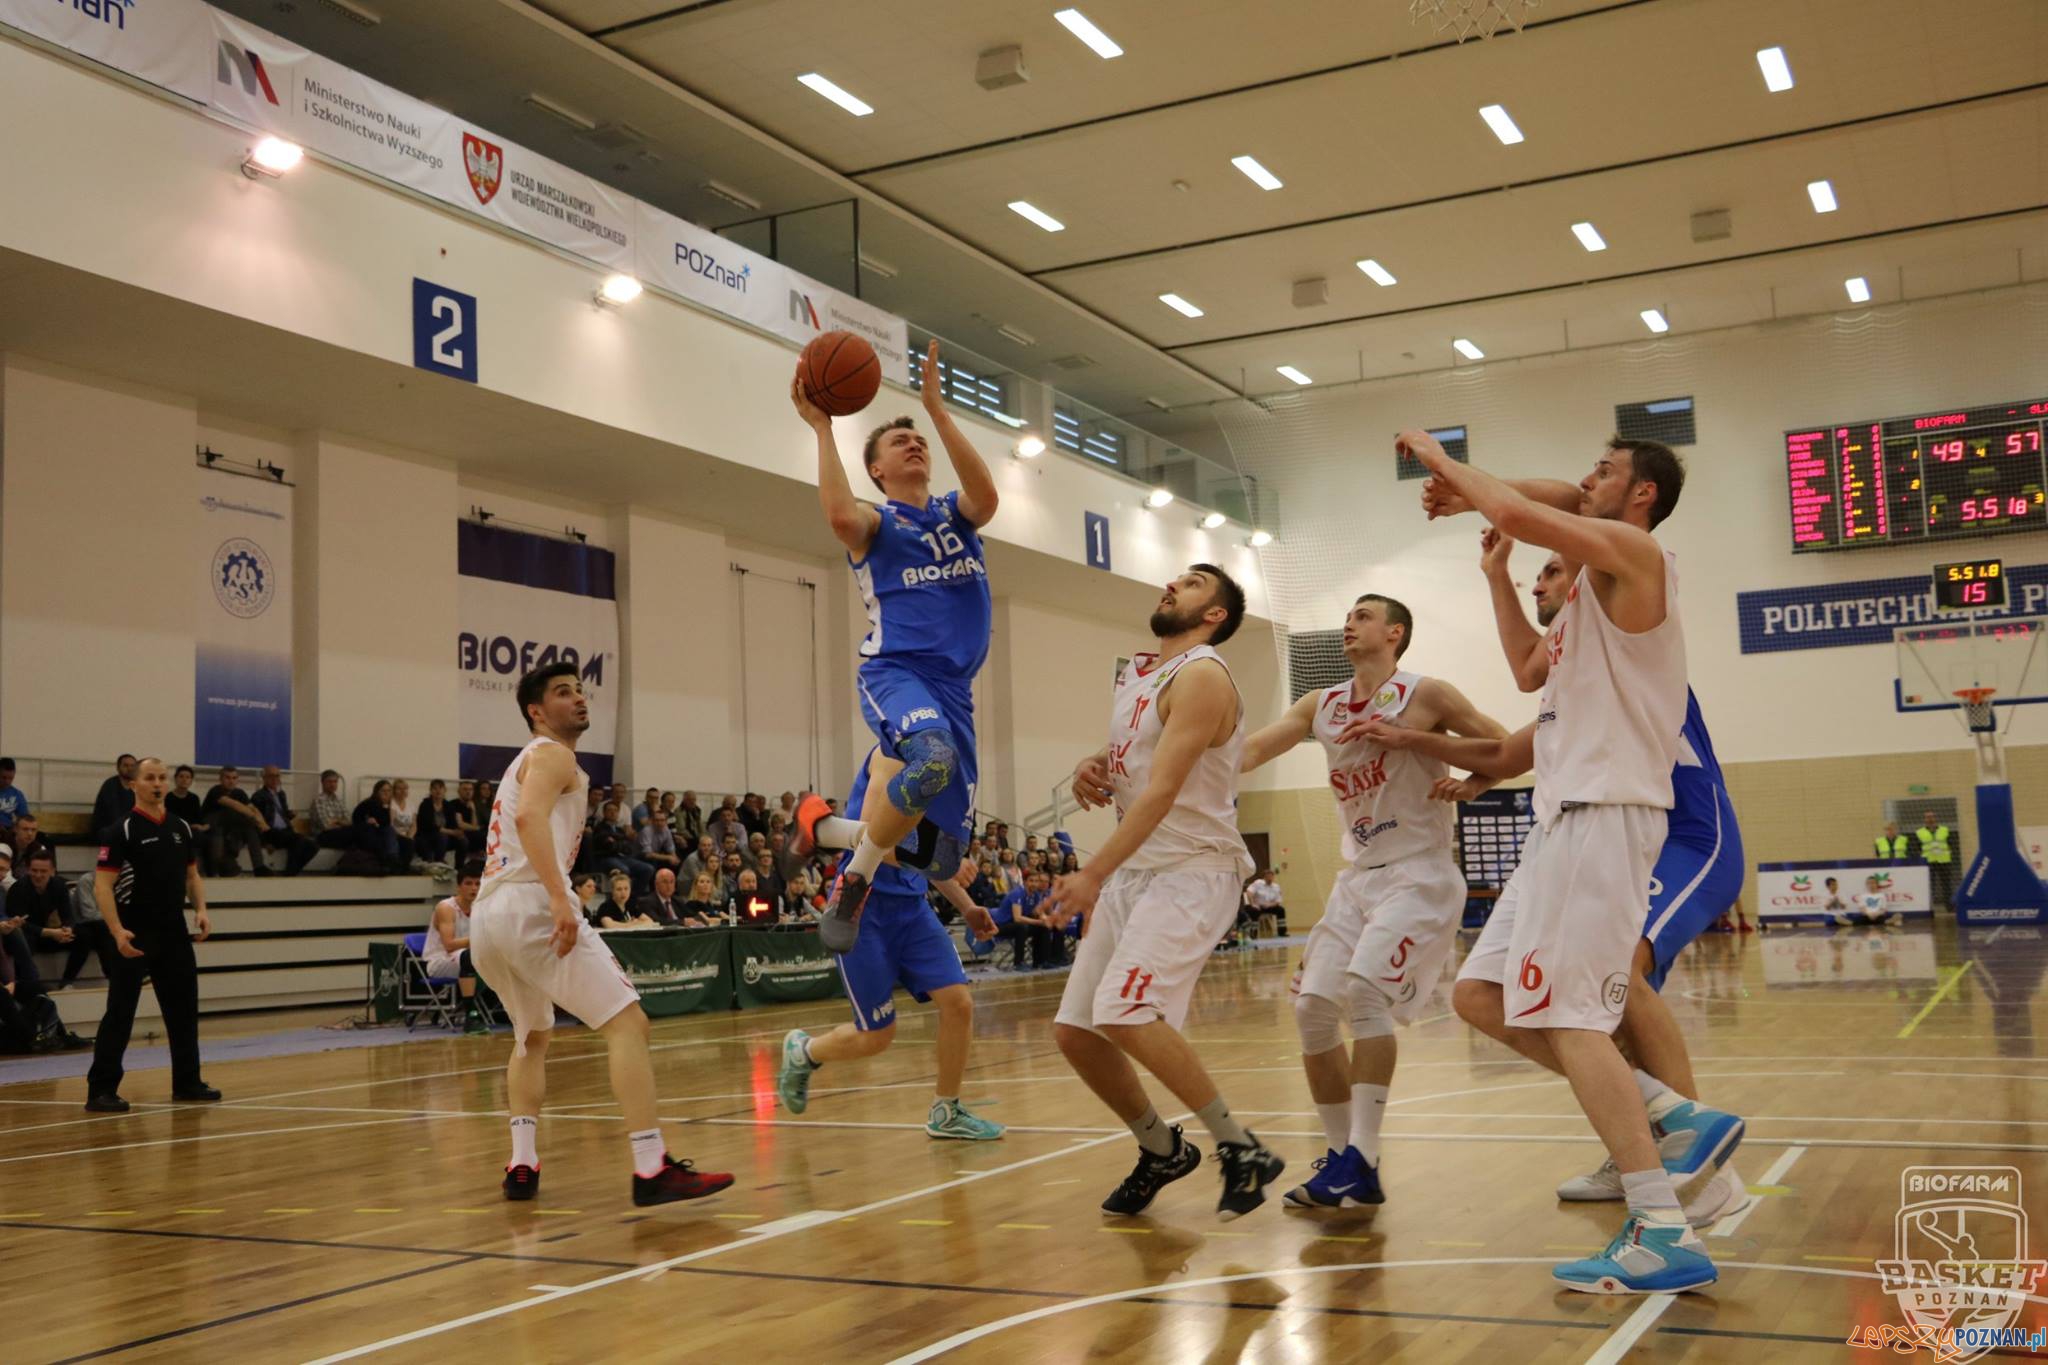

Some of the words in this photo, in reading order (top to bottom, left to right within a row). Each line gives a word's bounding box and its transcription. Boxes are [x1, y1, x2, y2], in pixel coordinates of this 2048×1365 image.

[304, 77, 385, 124] Ministerstwo
[387, 113, 422, 140] Nauki
[311, 102, 384, 144] Szkolnictwa
[431, 295, 463, 369] 2
[1914, 413, 1967, 429] BIOFARM
[1932, 440, 1964, 462] 49
[2005, 431, 2040, 455] 57
[919, 522, 965, 561] 16
[1094, 520, 1104, 564] 1
[1962, 582, 1987, 603] 15
[1389, 936, 1416, 971] 5
[1516, 948, 1544, 991] 6
[1119, 966, 1153, 1002] 11
